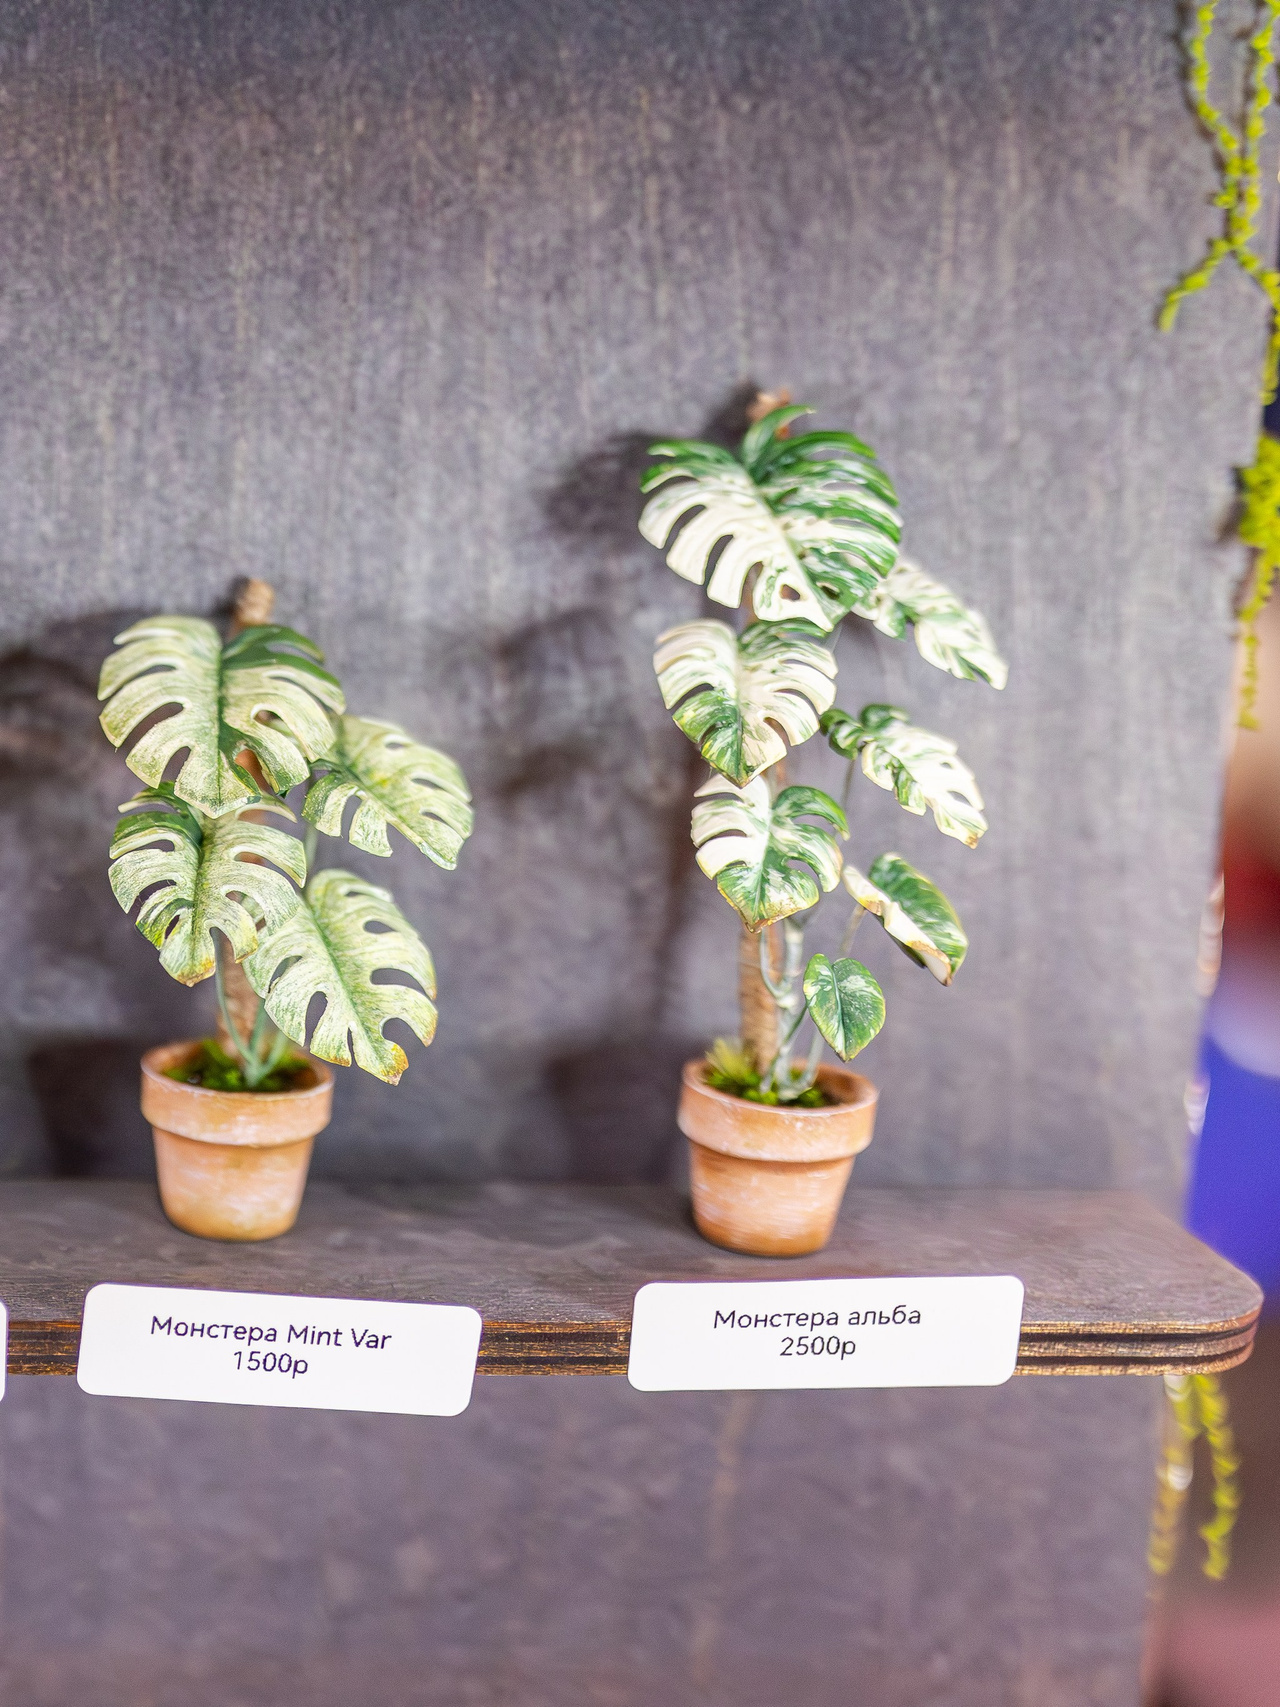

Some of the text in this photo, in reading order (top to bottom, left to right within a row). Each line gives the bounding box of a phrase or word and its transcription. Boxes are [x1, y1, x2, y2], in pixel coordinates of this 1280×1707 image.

[150, 1315, 393, 1350] Монстера Mint Var
[713, 1304, 921, 1332] Монстера альба
